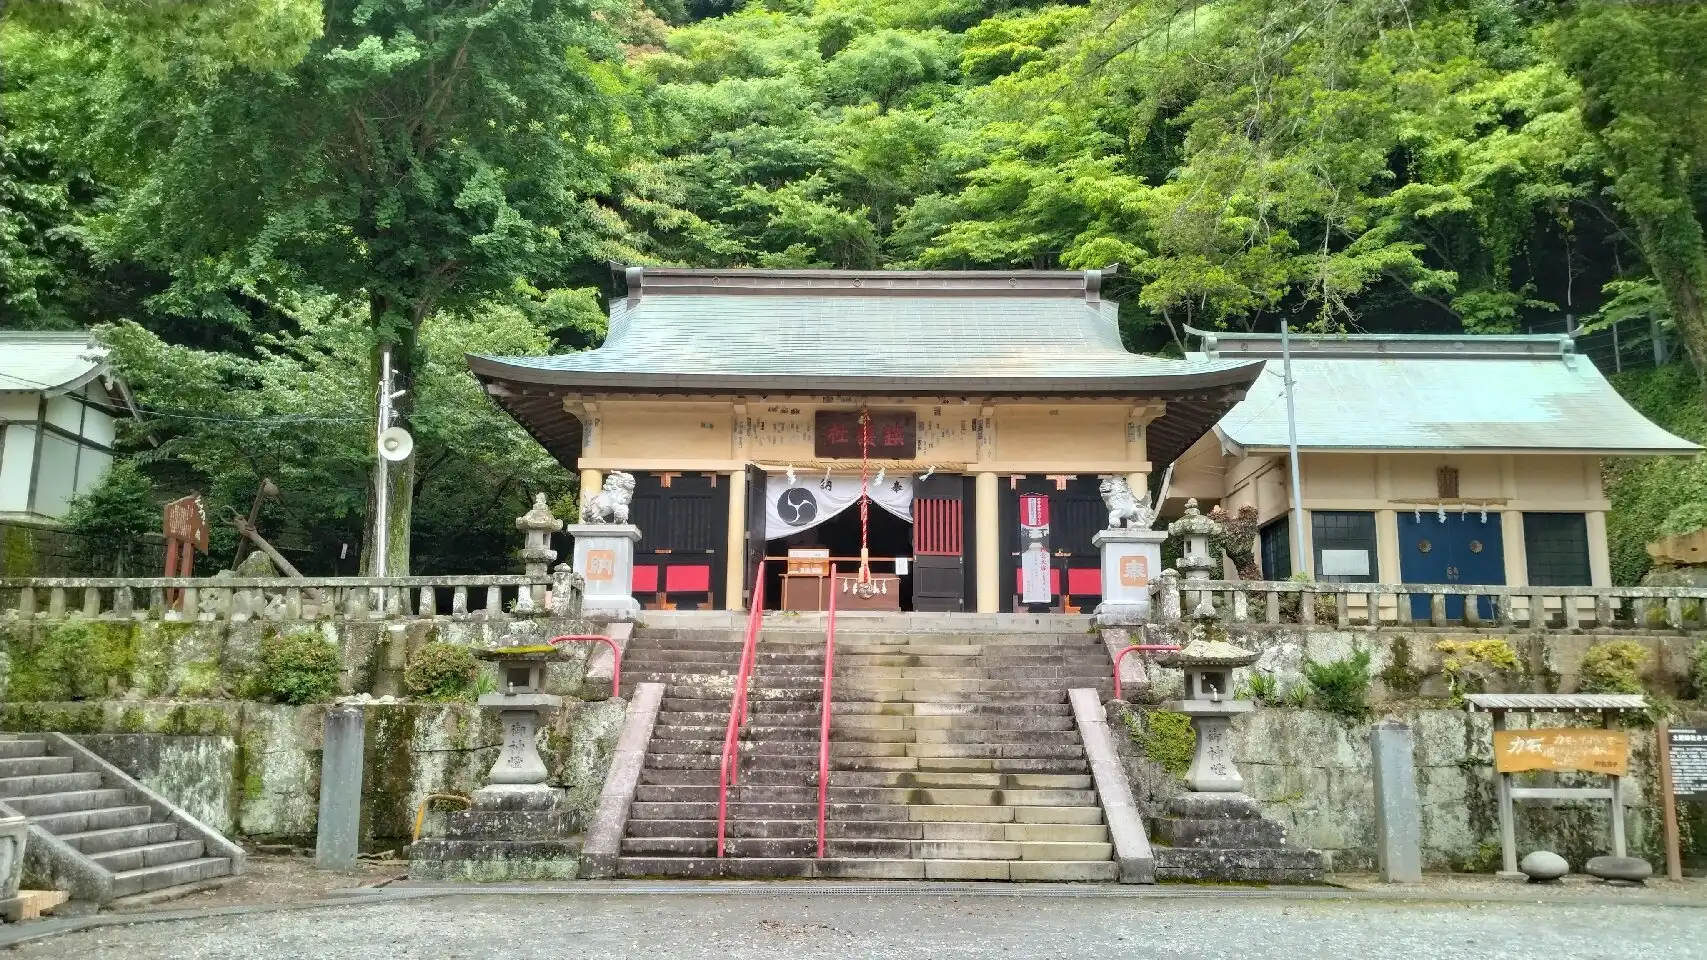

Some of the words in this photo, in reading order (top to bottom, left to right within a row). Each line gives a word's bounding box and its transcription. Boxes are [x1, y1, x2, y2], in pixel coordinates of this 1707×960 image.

[891, 480, 903, 493] 奉
[590, 555, 612, 575] 納
[1123, 559, 1146, 583] 奉
